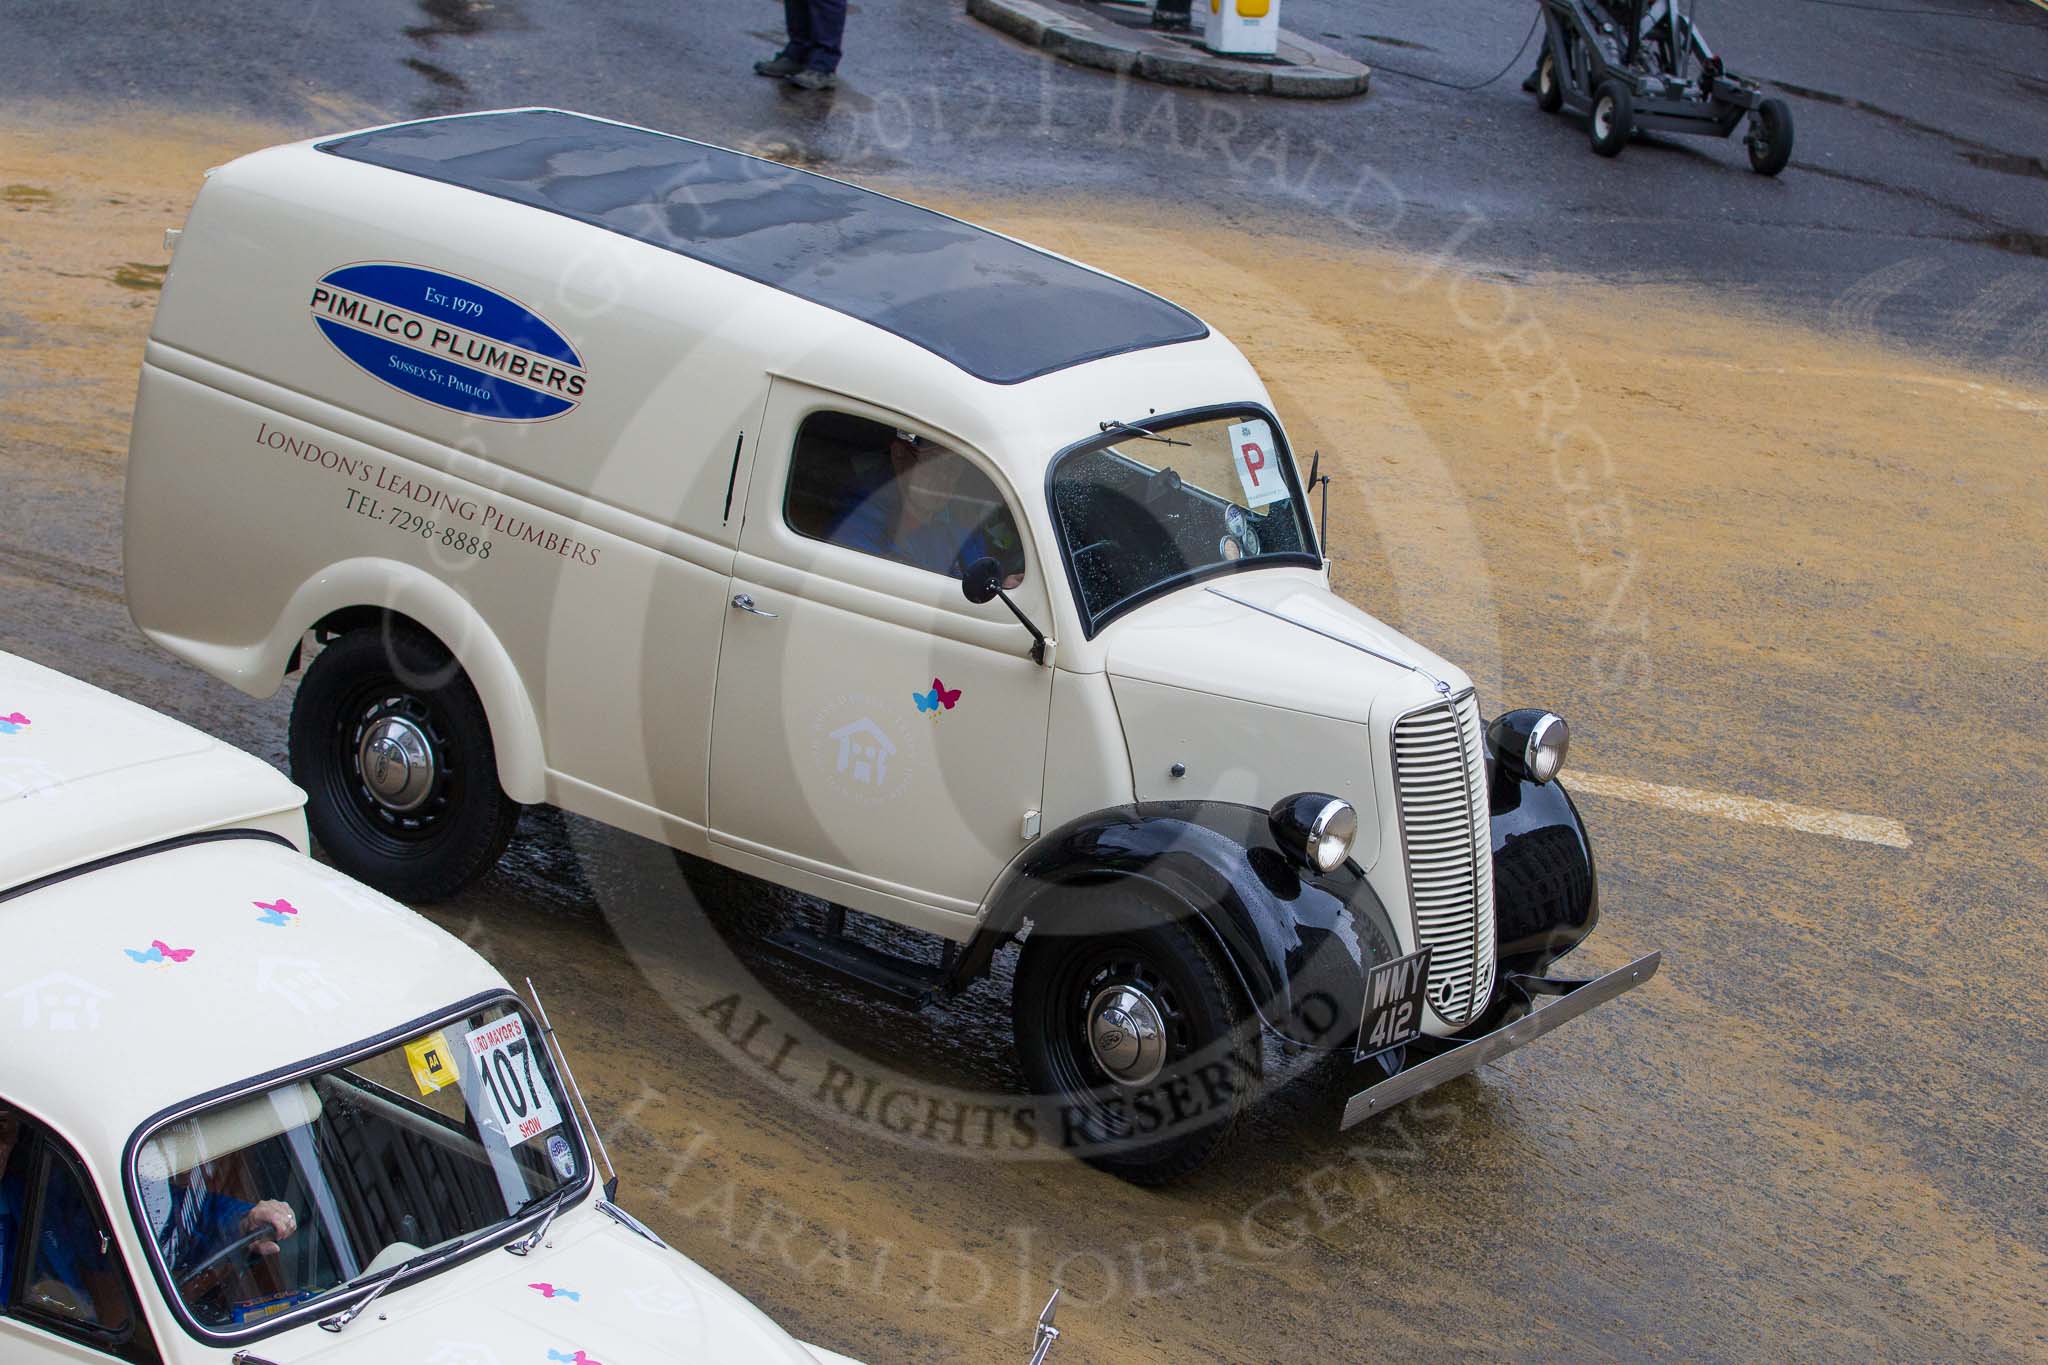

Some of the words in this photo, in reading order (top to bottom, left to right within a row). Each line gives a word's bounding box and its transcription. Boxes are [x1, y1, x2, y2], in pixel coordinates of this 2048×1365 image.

[452, 296, 484, 318] 1979
[310, 288, 423, 340] PIMLICO
[431, 327, 588, 397] PLUMBERS
[1241, 443, 1265, 487] P
[256, 423, 373, 482] LONDON'S
[376, 467, 477, 521] LEADING
[482, 505, 602, 567] PLUMBERS
[345, 488, 385, 521] TEL:
[389, 507, 492, 560] 7298-8888
[1373, 954, 1426, 1010] WMY
[1369, 1001, 1413, 1048] 412
[429, 1052, 439, 1068] AA
[481, 1038, 542, 1125] 107
[520, 1118, 543, 1139] SHOW
